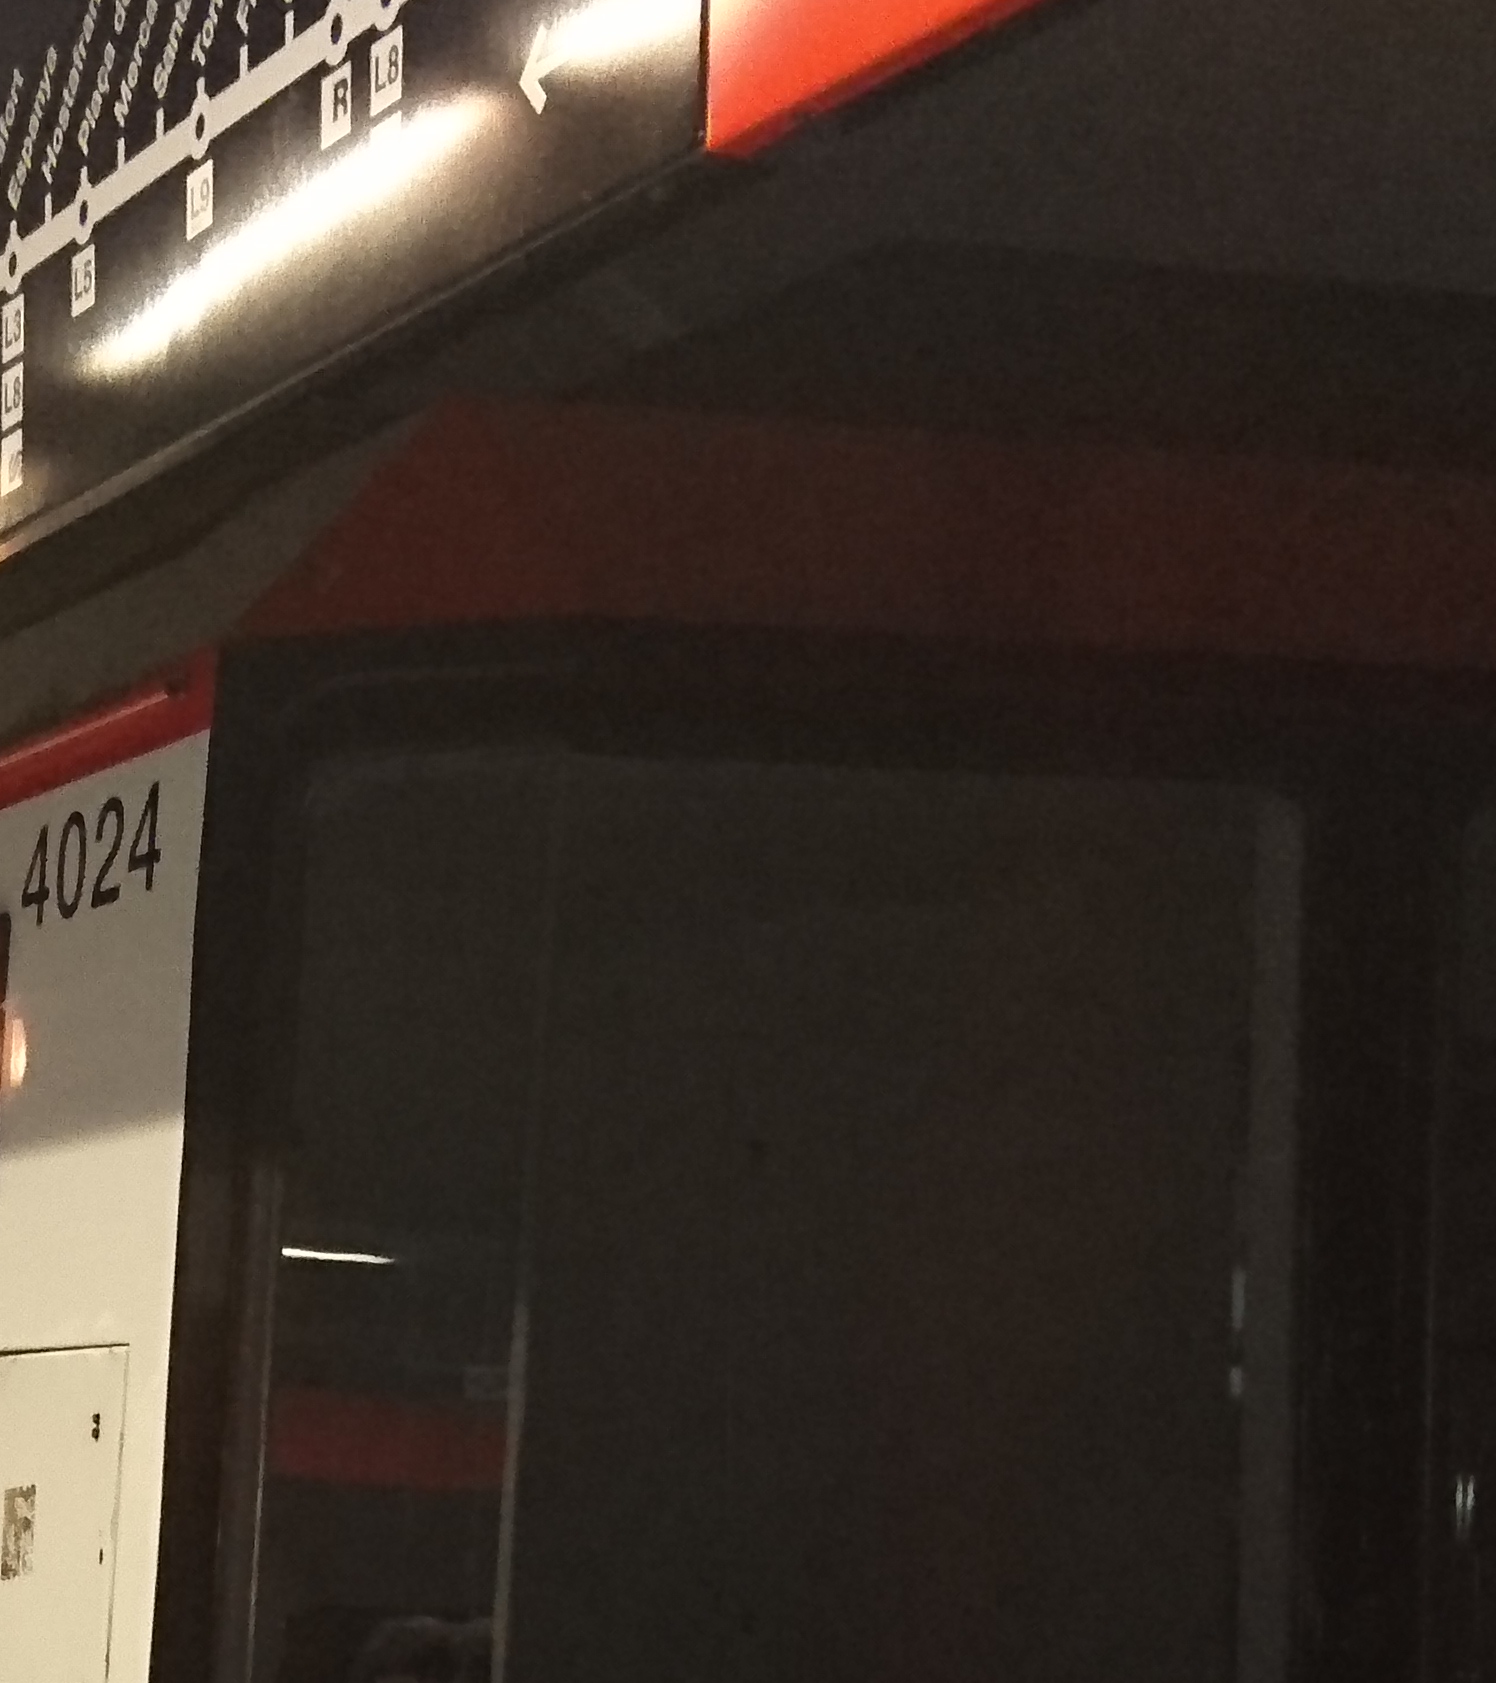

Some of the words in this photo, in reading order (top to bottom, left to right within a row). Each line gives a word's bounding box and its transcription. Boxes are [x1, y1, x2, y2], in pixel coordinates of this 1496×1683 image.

[374, 44, 400, 94] L8
[78, 41, 116, 156] Plaça
[332, 78, 349, 123] R
[7, 45, 58, 211] Espanya
[189, 178, 211, 220] L9
[5, 304, 22, 347] L3
[5, 374, 23, 417] L8
[21, 780, 162, 926] 4024
